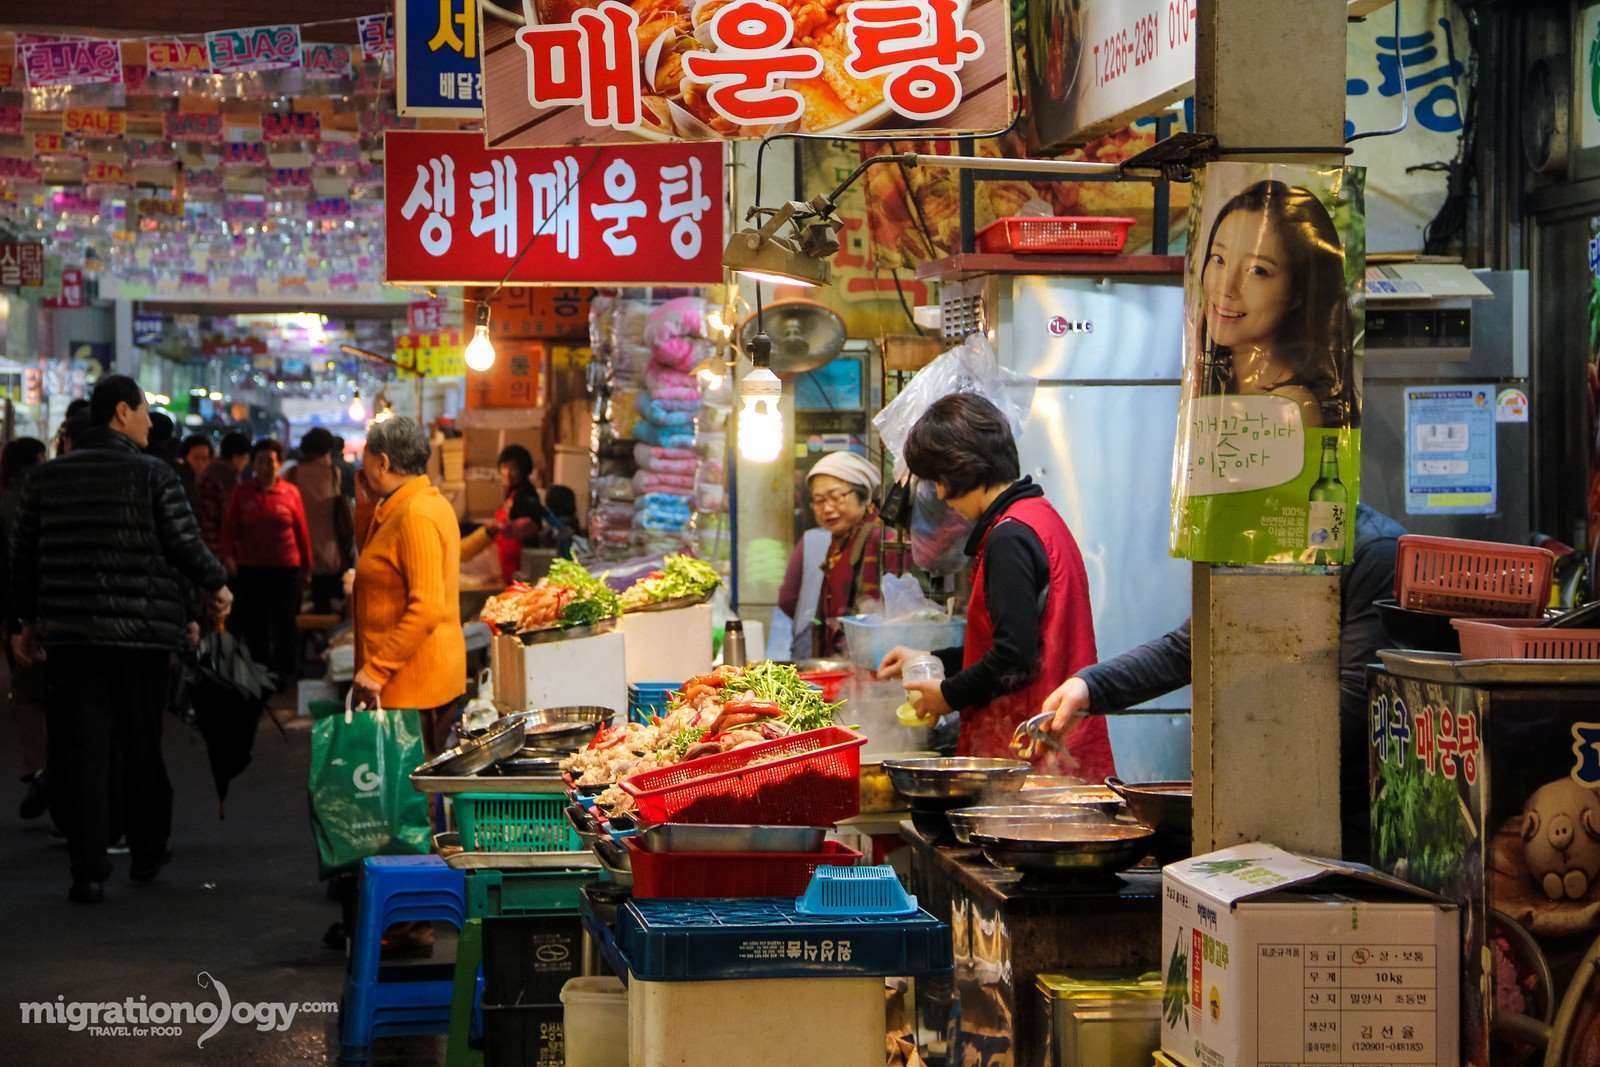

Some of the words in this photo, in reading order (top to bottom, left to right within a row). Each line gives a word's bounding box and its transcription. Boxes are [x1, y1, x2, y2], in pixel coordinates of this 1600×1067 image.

[516, 0, 984, 129] 매운탕
[66, 111, 121, 130] SALE
[401, 154, 711, 259] 생태매운탕
[1371, 694, 1411, 768] 대구
[1415, 704, 1481, 786] 매운탕
[1376, 972, 1402, 984] 10kg
